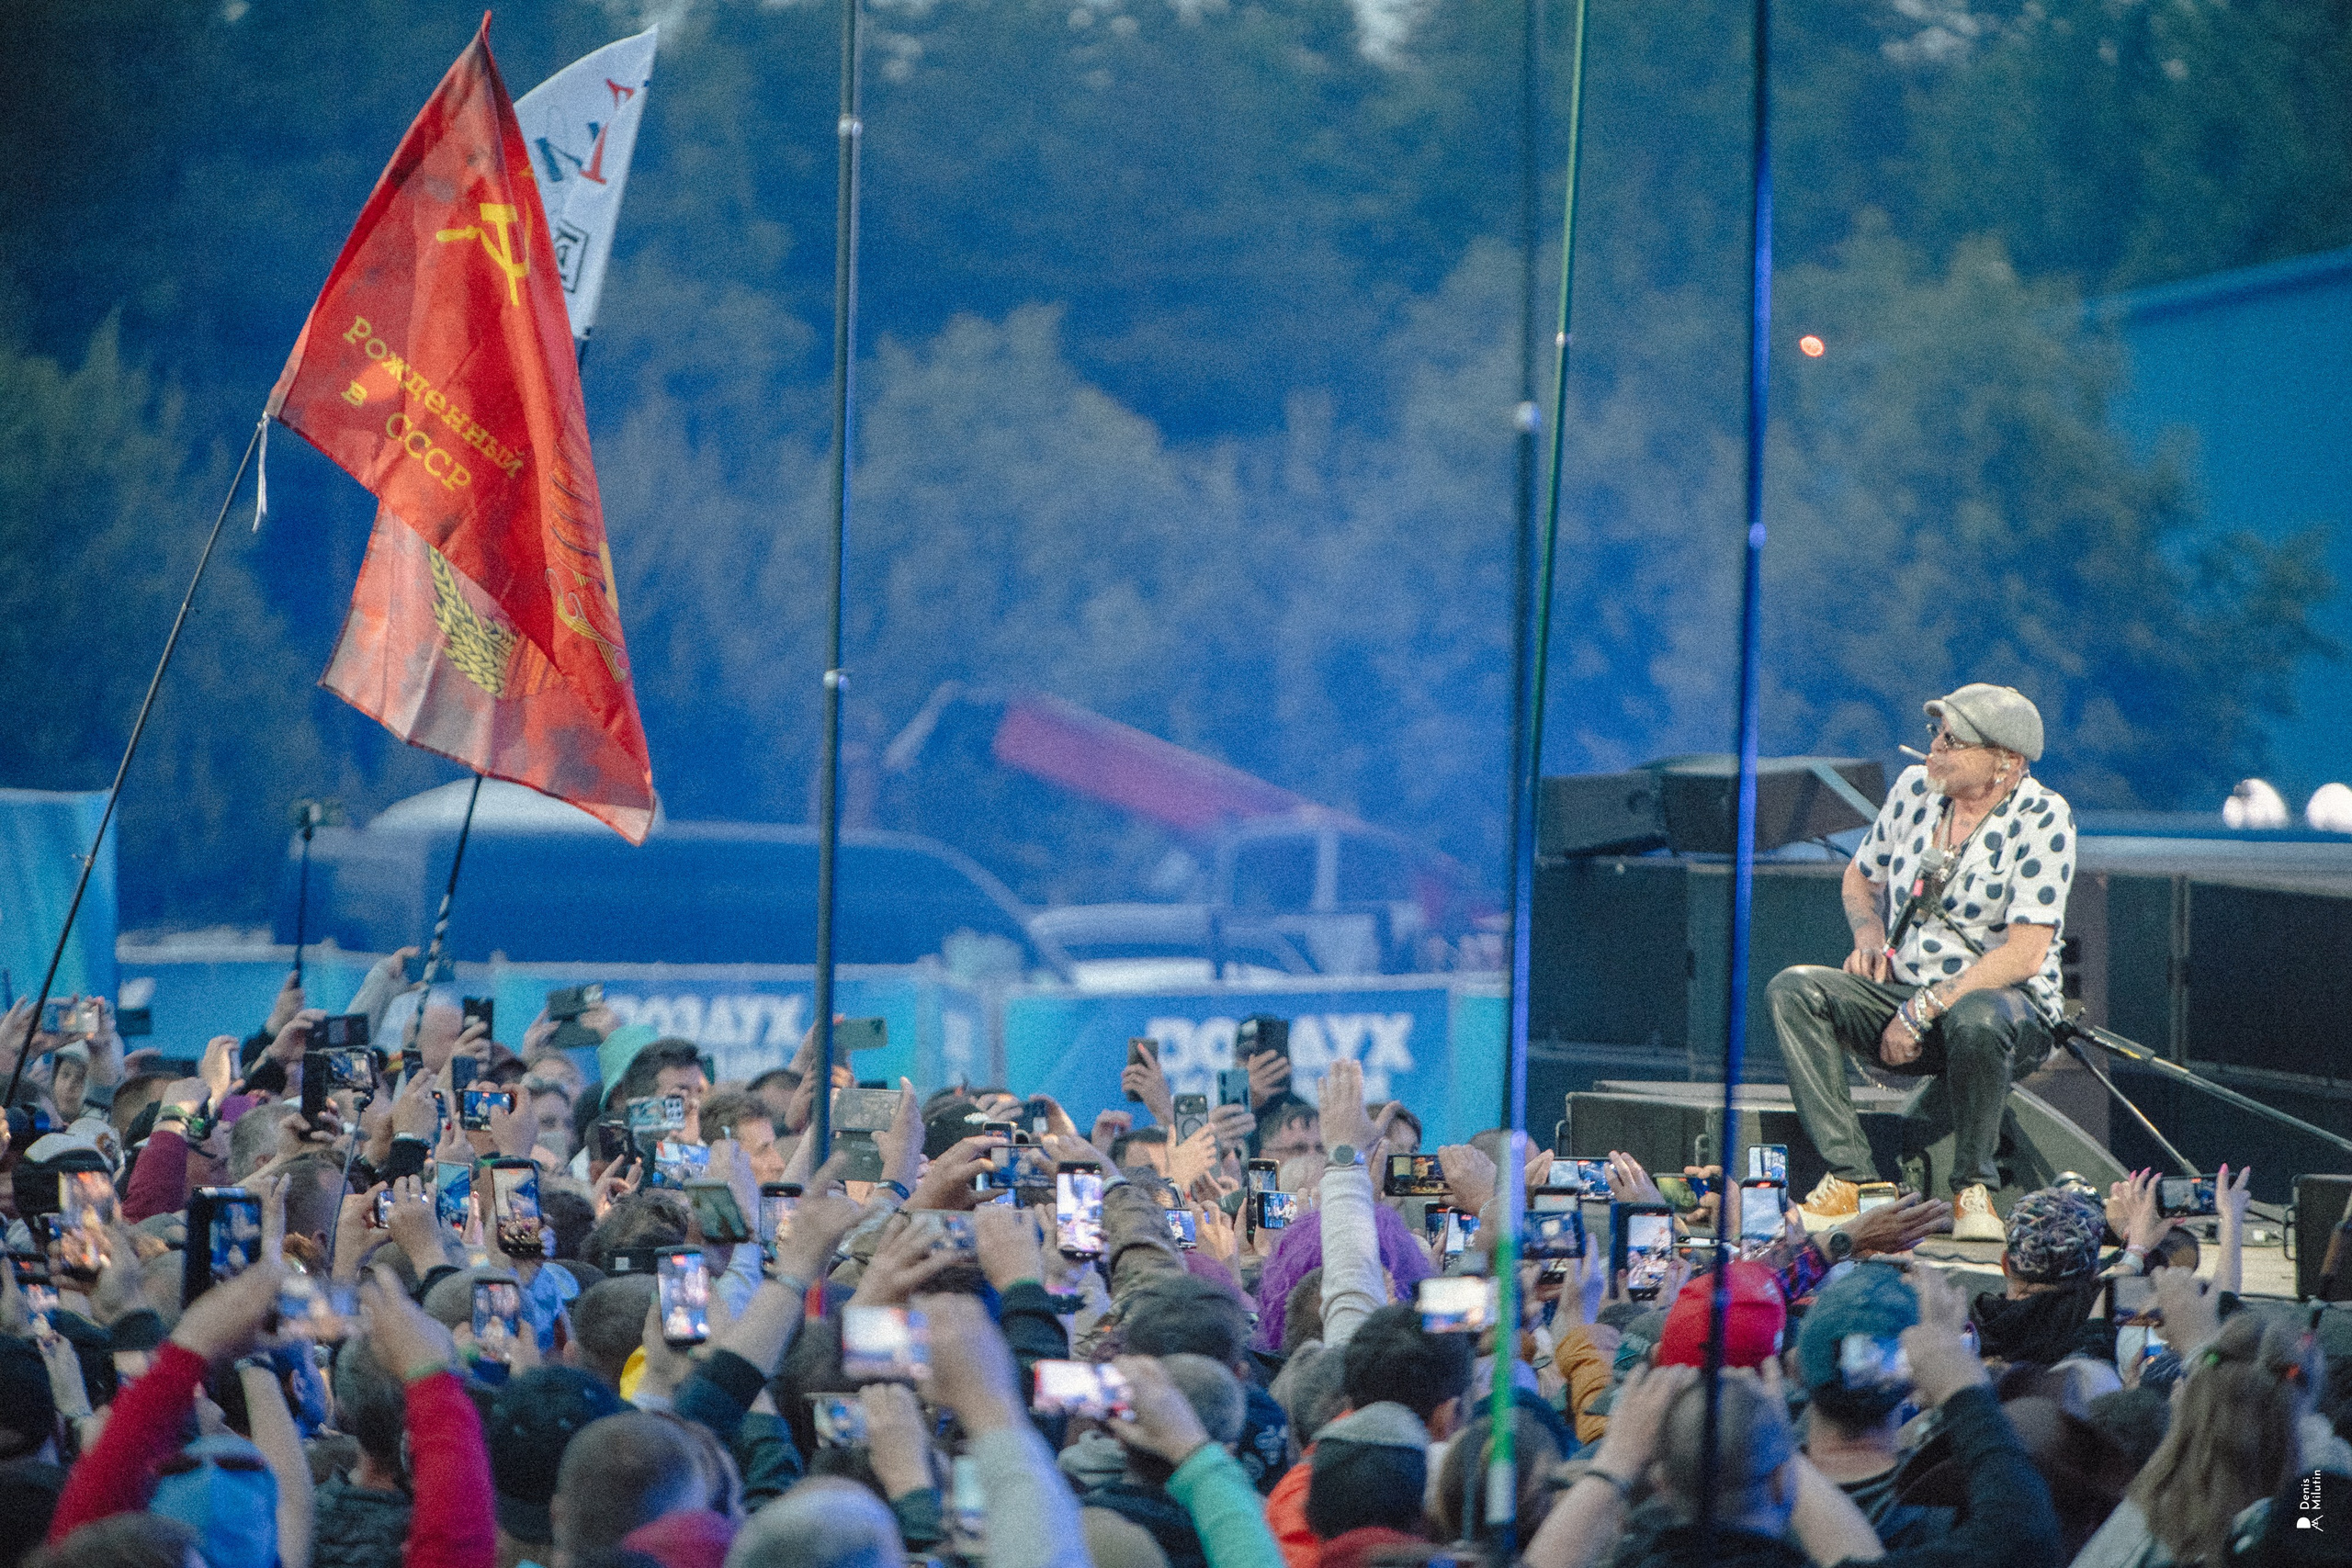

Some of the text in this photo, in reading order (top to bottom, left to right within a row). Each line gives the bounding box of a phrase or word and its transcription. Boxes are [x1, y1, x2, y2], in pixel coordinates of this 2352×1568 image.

[343, 315, 523, 478] Рожденный
[386, 412, 471, 491] СССР
[1145, 1012, 1415, 1072] ВОДУХ
